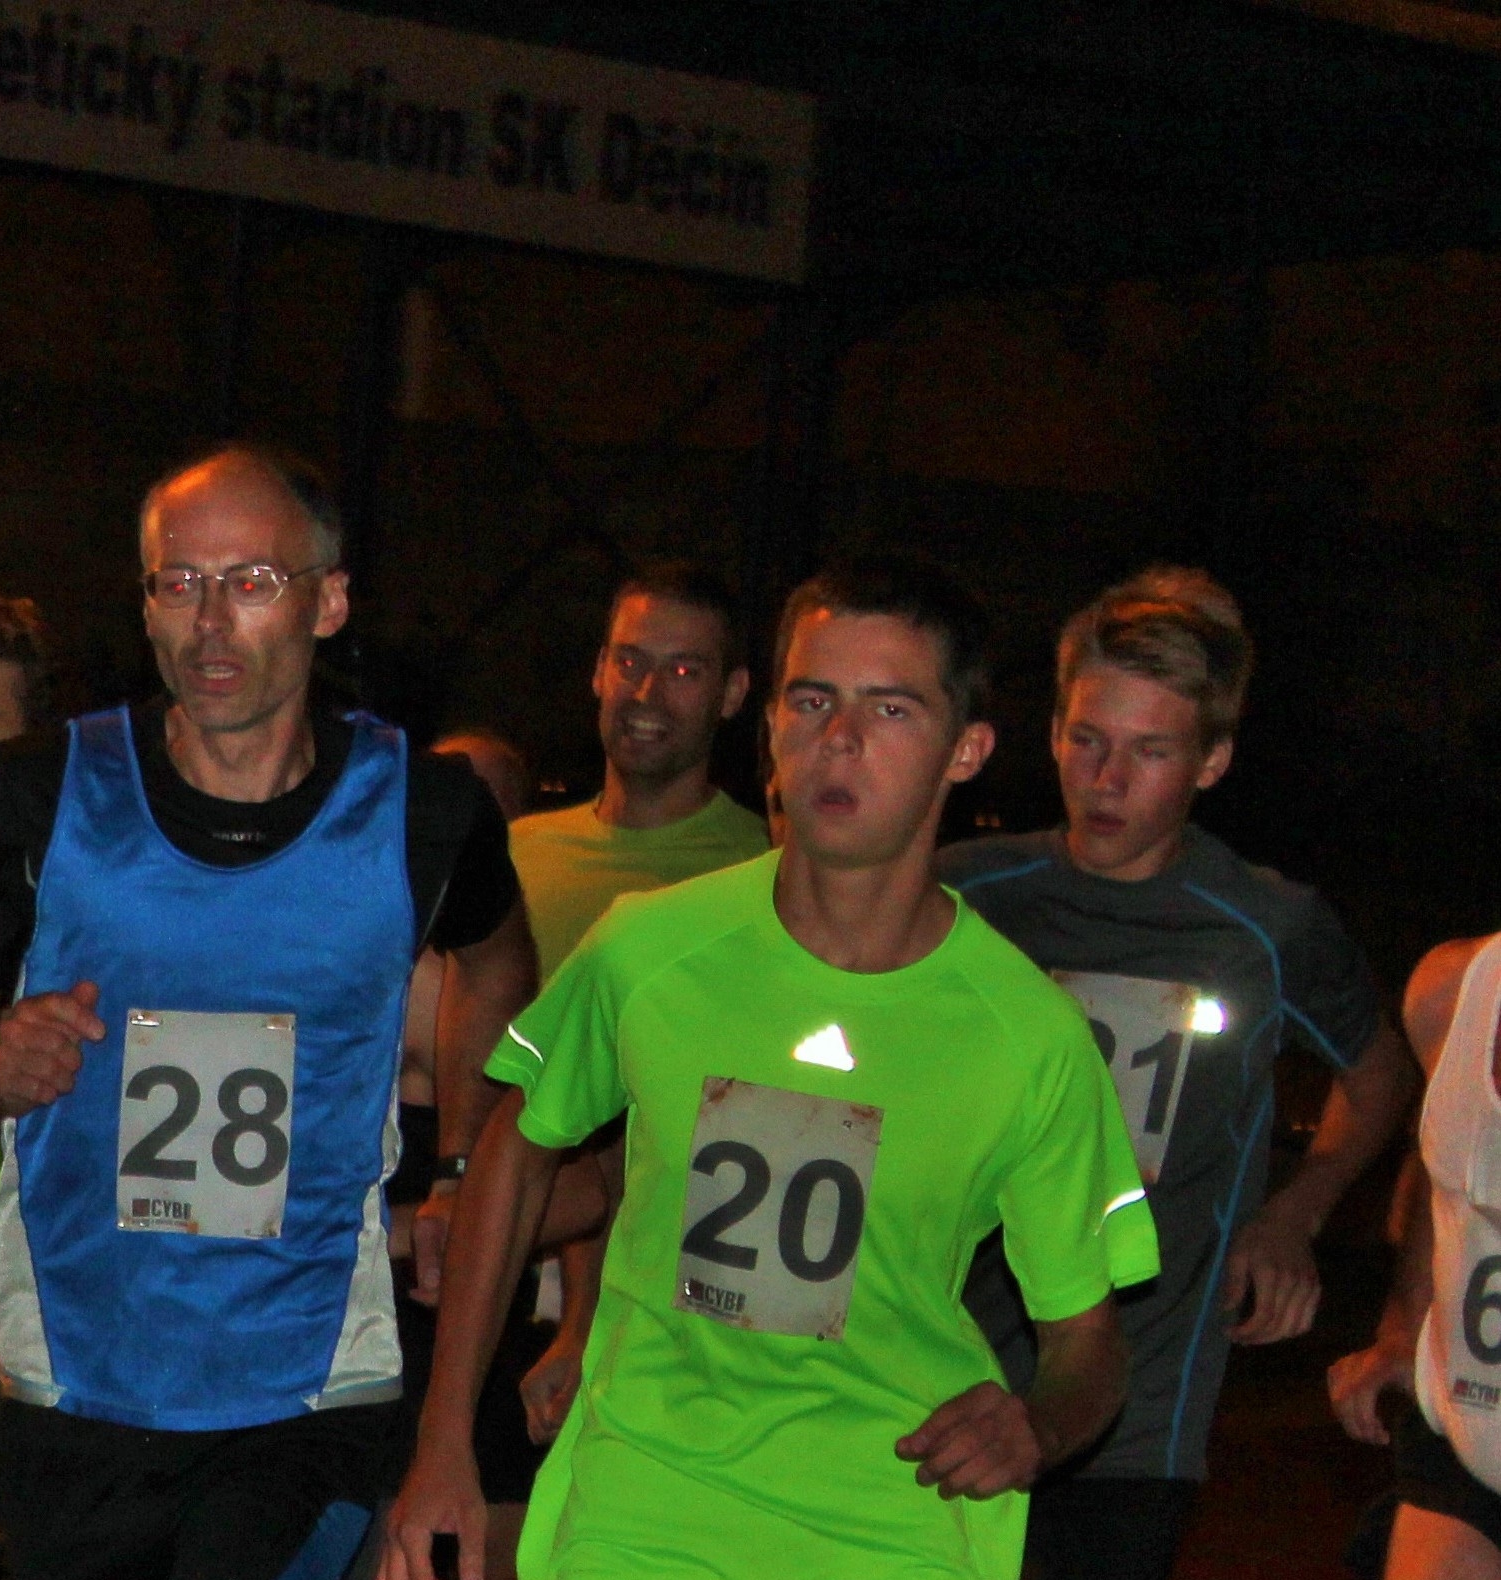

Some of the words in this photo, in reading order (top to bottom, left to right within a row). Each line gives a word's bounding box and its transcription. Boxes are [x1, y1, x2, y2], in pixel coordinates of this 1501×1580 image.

[220, 55, 467, 178] stadion
[487, 92, 577, 193] SK
[120, 1064, 289, 1187] 28
[681, 1140, 865, 1283] 20
